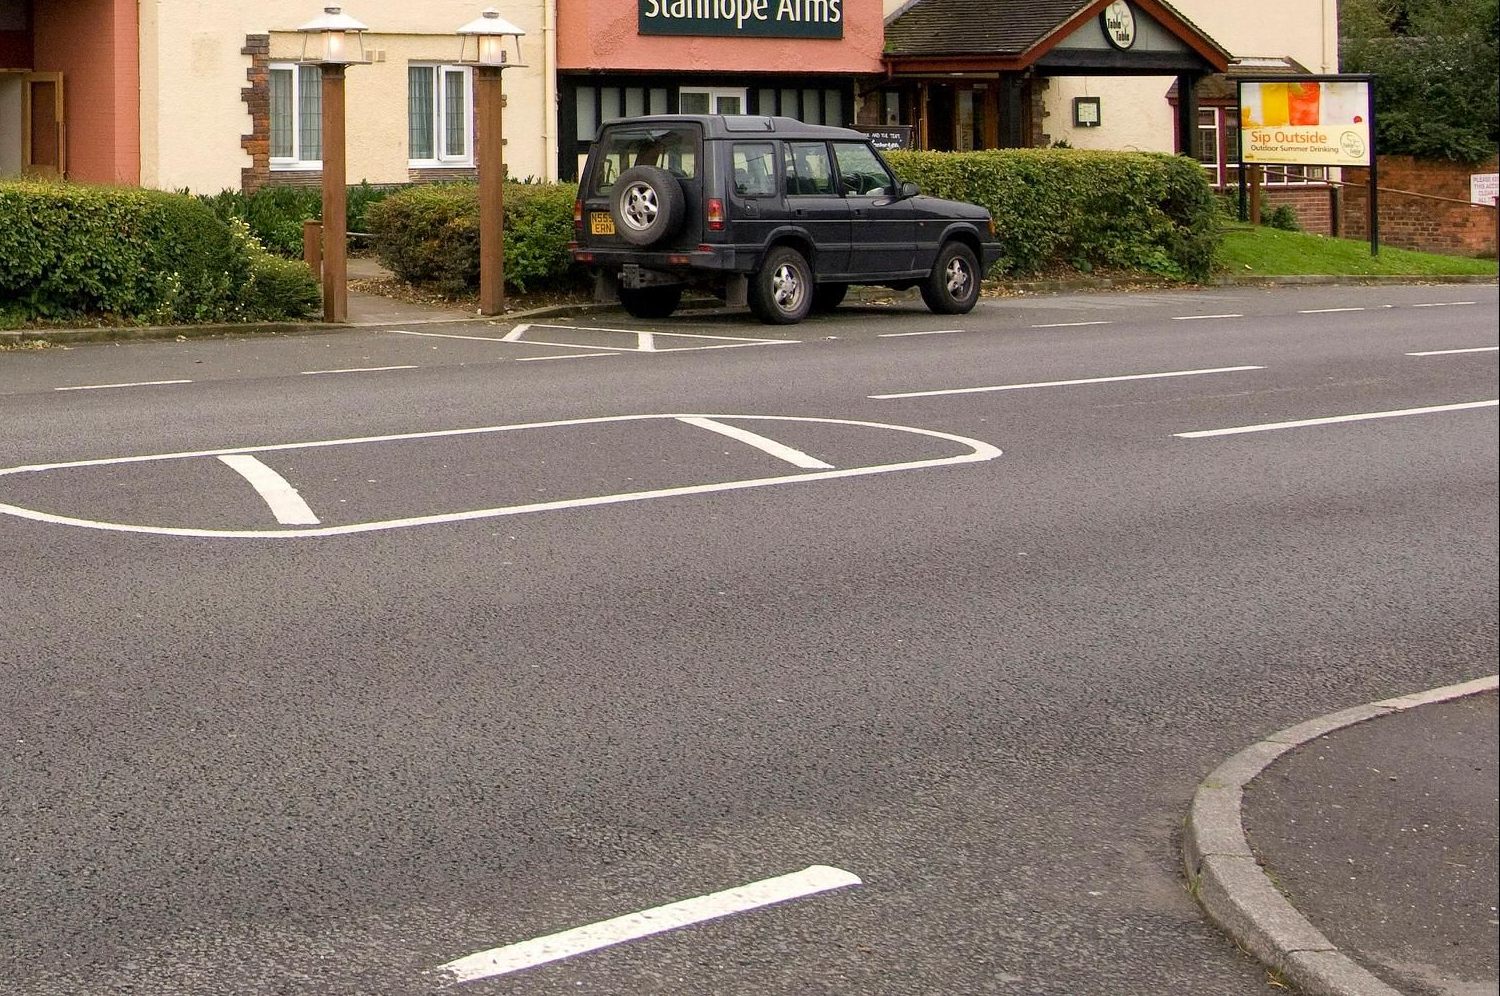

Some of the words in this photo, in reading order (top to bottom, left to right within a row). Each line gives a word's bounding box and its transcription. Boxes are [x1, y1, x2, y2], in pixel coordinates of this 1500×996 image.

[1107, 19, 1121, 29] Table
[1116, 30, 1130, 41] Table
[1251, 131, 1271, 145] Sip
[1275, 131, 1328, 144] Outside
[1250, 144, 1278, 152] Outdoor
[1280, 145, 1308, 153] Summer
[1310, 145, 1339, 154] Drinking
[595, 224, 612, 233] ERN
